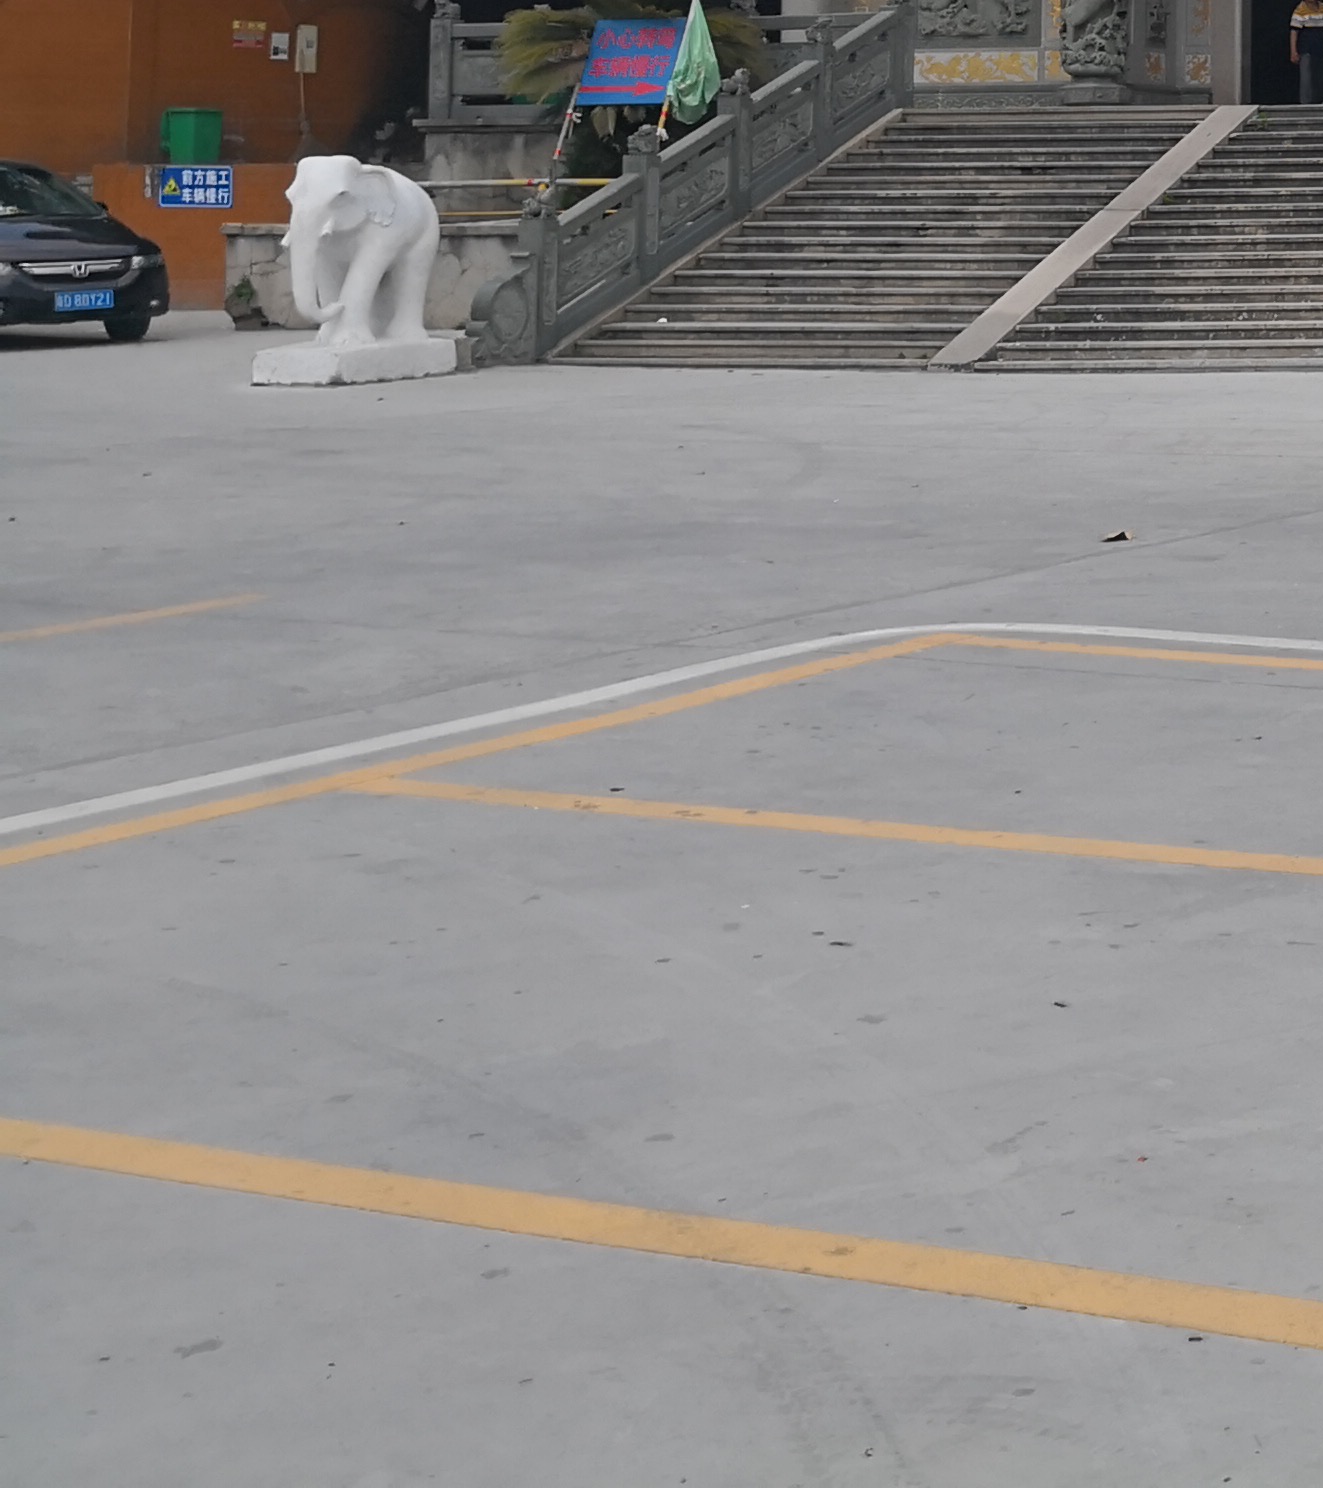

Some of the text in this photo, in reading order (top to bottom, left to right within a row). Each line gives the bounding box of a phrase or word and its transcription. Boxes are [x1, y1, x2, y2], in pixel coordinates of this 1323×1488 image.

[181, 169, 230, 186] 前方施工
[181, 187, 230, 204] 车辆慢行
